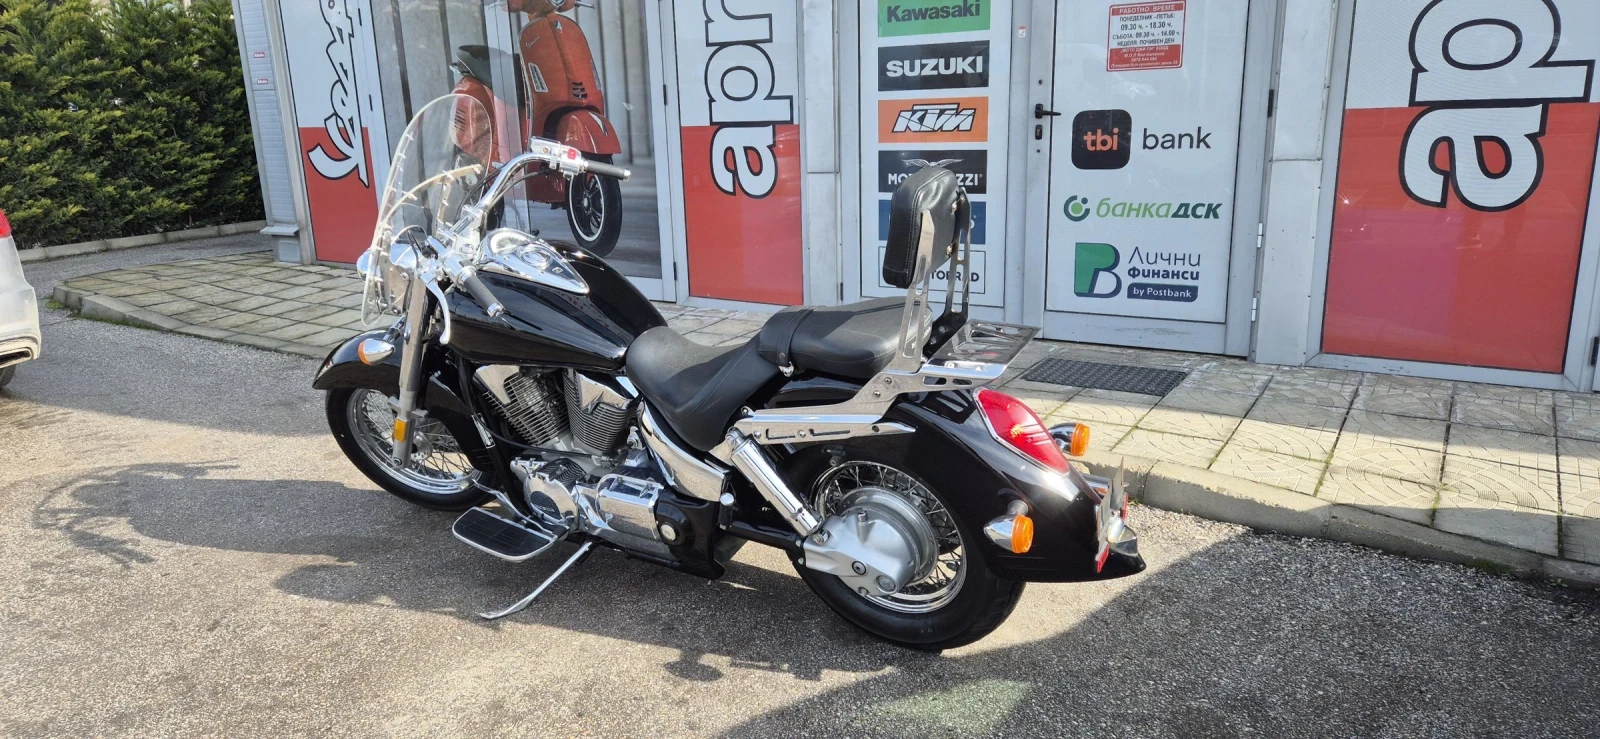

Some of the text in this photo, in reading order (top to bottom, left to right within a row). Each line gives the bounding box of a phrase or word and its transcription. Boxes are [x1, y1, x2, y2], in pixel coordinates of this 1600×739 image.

[887, 0, 980, 22] Kawasaki
[886, 56, 983, 77] SUZUKI
[891, 102, 977, 133] KTM
[1083, 126, 1212, 151] tbi bank
[1128, 246, 1201, 267] Лични
[1127, 266, 1200, 280] Финанси
[1133, 287, 1192, 298] by Postbank
